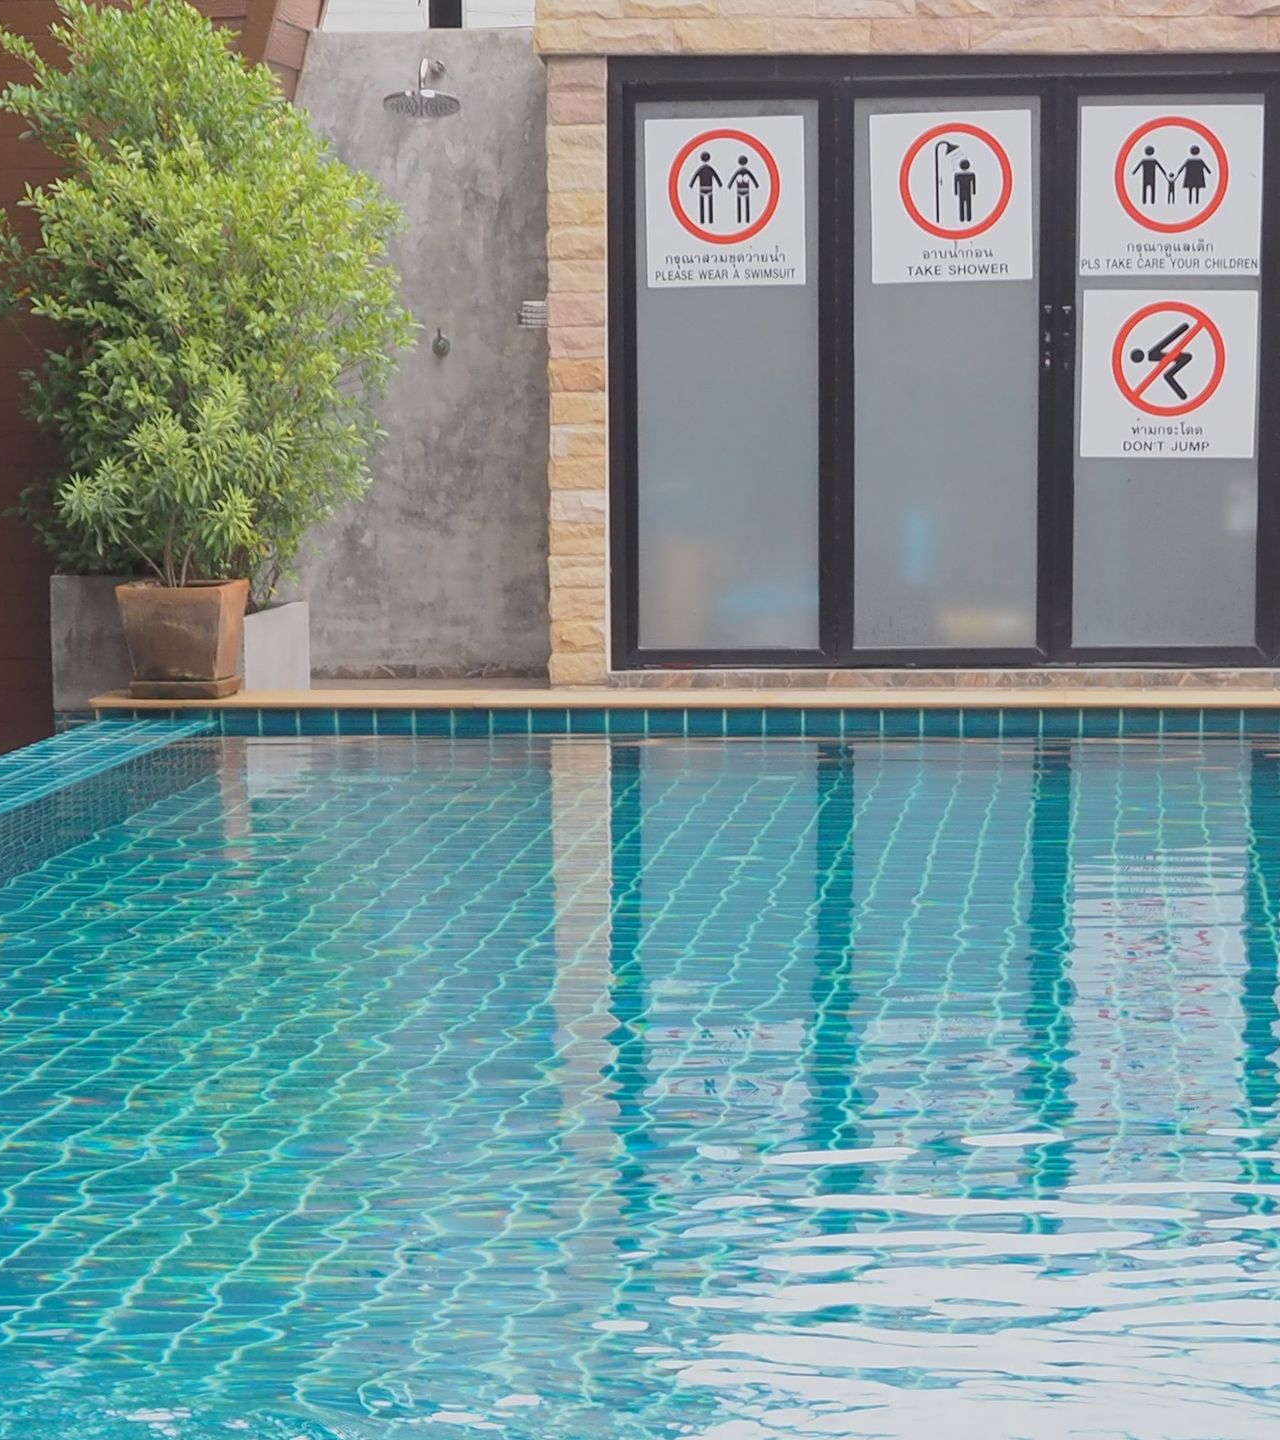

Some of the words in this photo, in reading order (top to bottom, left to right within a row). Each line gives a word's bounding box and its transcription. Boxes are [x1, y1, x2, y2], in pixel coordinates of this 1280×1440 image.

[922, 240, 993, 259] อาบน้ำก่อน
[1127, 239, 1213, 257] กรุณาดูแลเด็ก
[1081, 259, 1100, 269] PLS
[1106, 259, 1131, 268] TAKE
[1137, 258, 1165, 269] CARE
[1171, 259, 1199, 268] YOUR
[1205, 258, 1258, 268] CHILDREN
[655, 270, 693, 281] PLEASE
[699, 269, 728, 280] WEAR
[733, 269, 740, 279] A
[745, 268, 796, 279] SWIMSUIT
[907, 265, 941, 276] TAKE
[949, 264, 1008, 275] SHOWER
[1123, 441, 1164, 451] DON'T
[1171, 441, 1209, 451] JUMP
